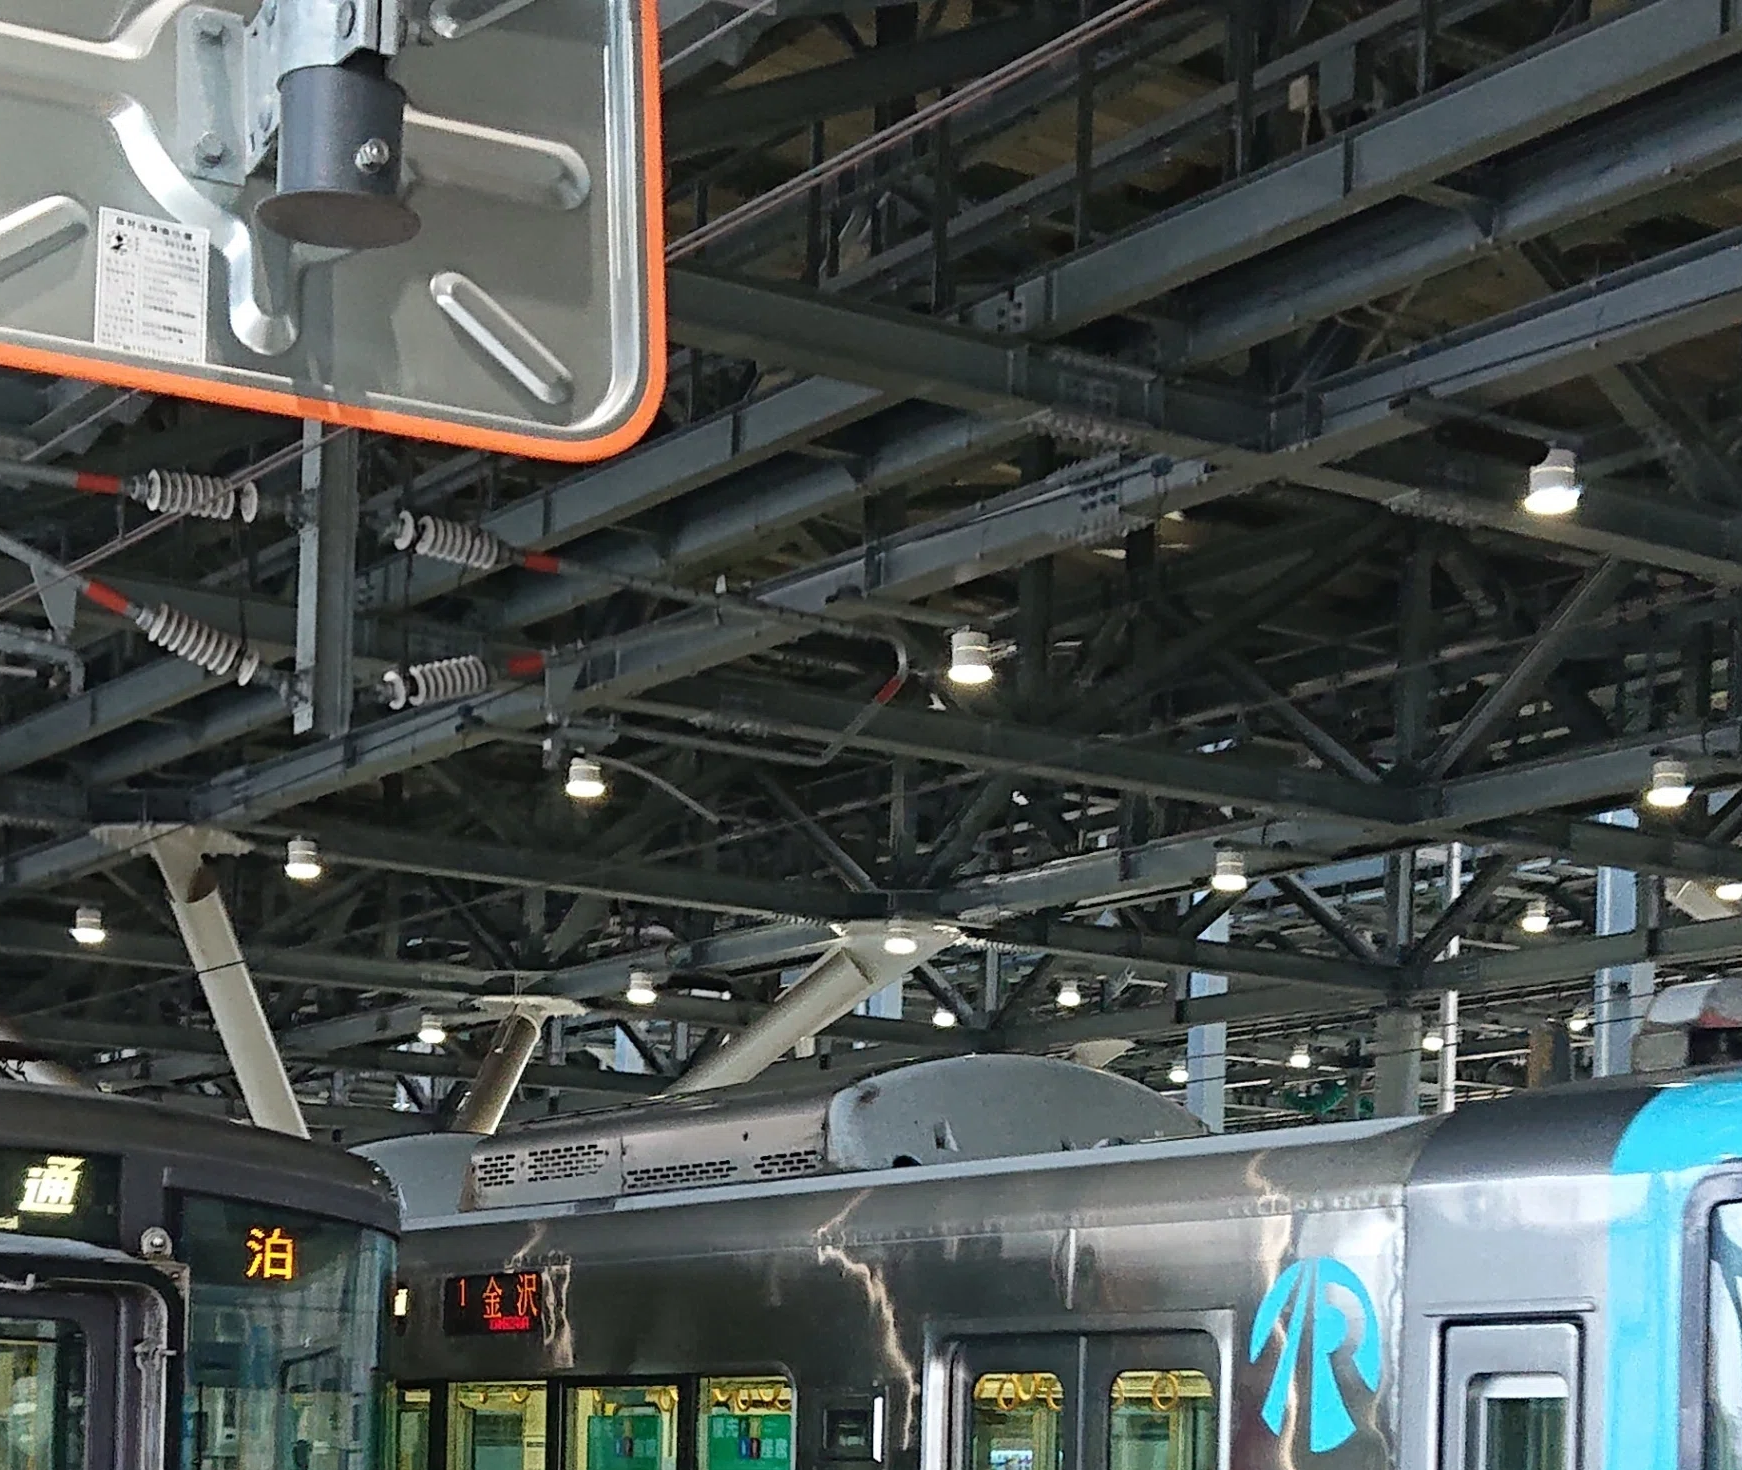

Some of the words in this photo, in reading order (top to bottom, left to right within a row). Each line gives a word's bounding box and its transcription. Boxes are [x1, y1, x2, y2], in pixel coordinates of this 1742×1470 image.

[246, 1228, 294, 1279] 泊
[459, 1278, 466, 1307] 1
[482, 1273, 538, 1318] 金沢
